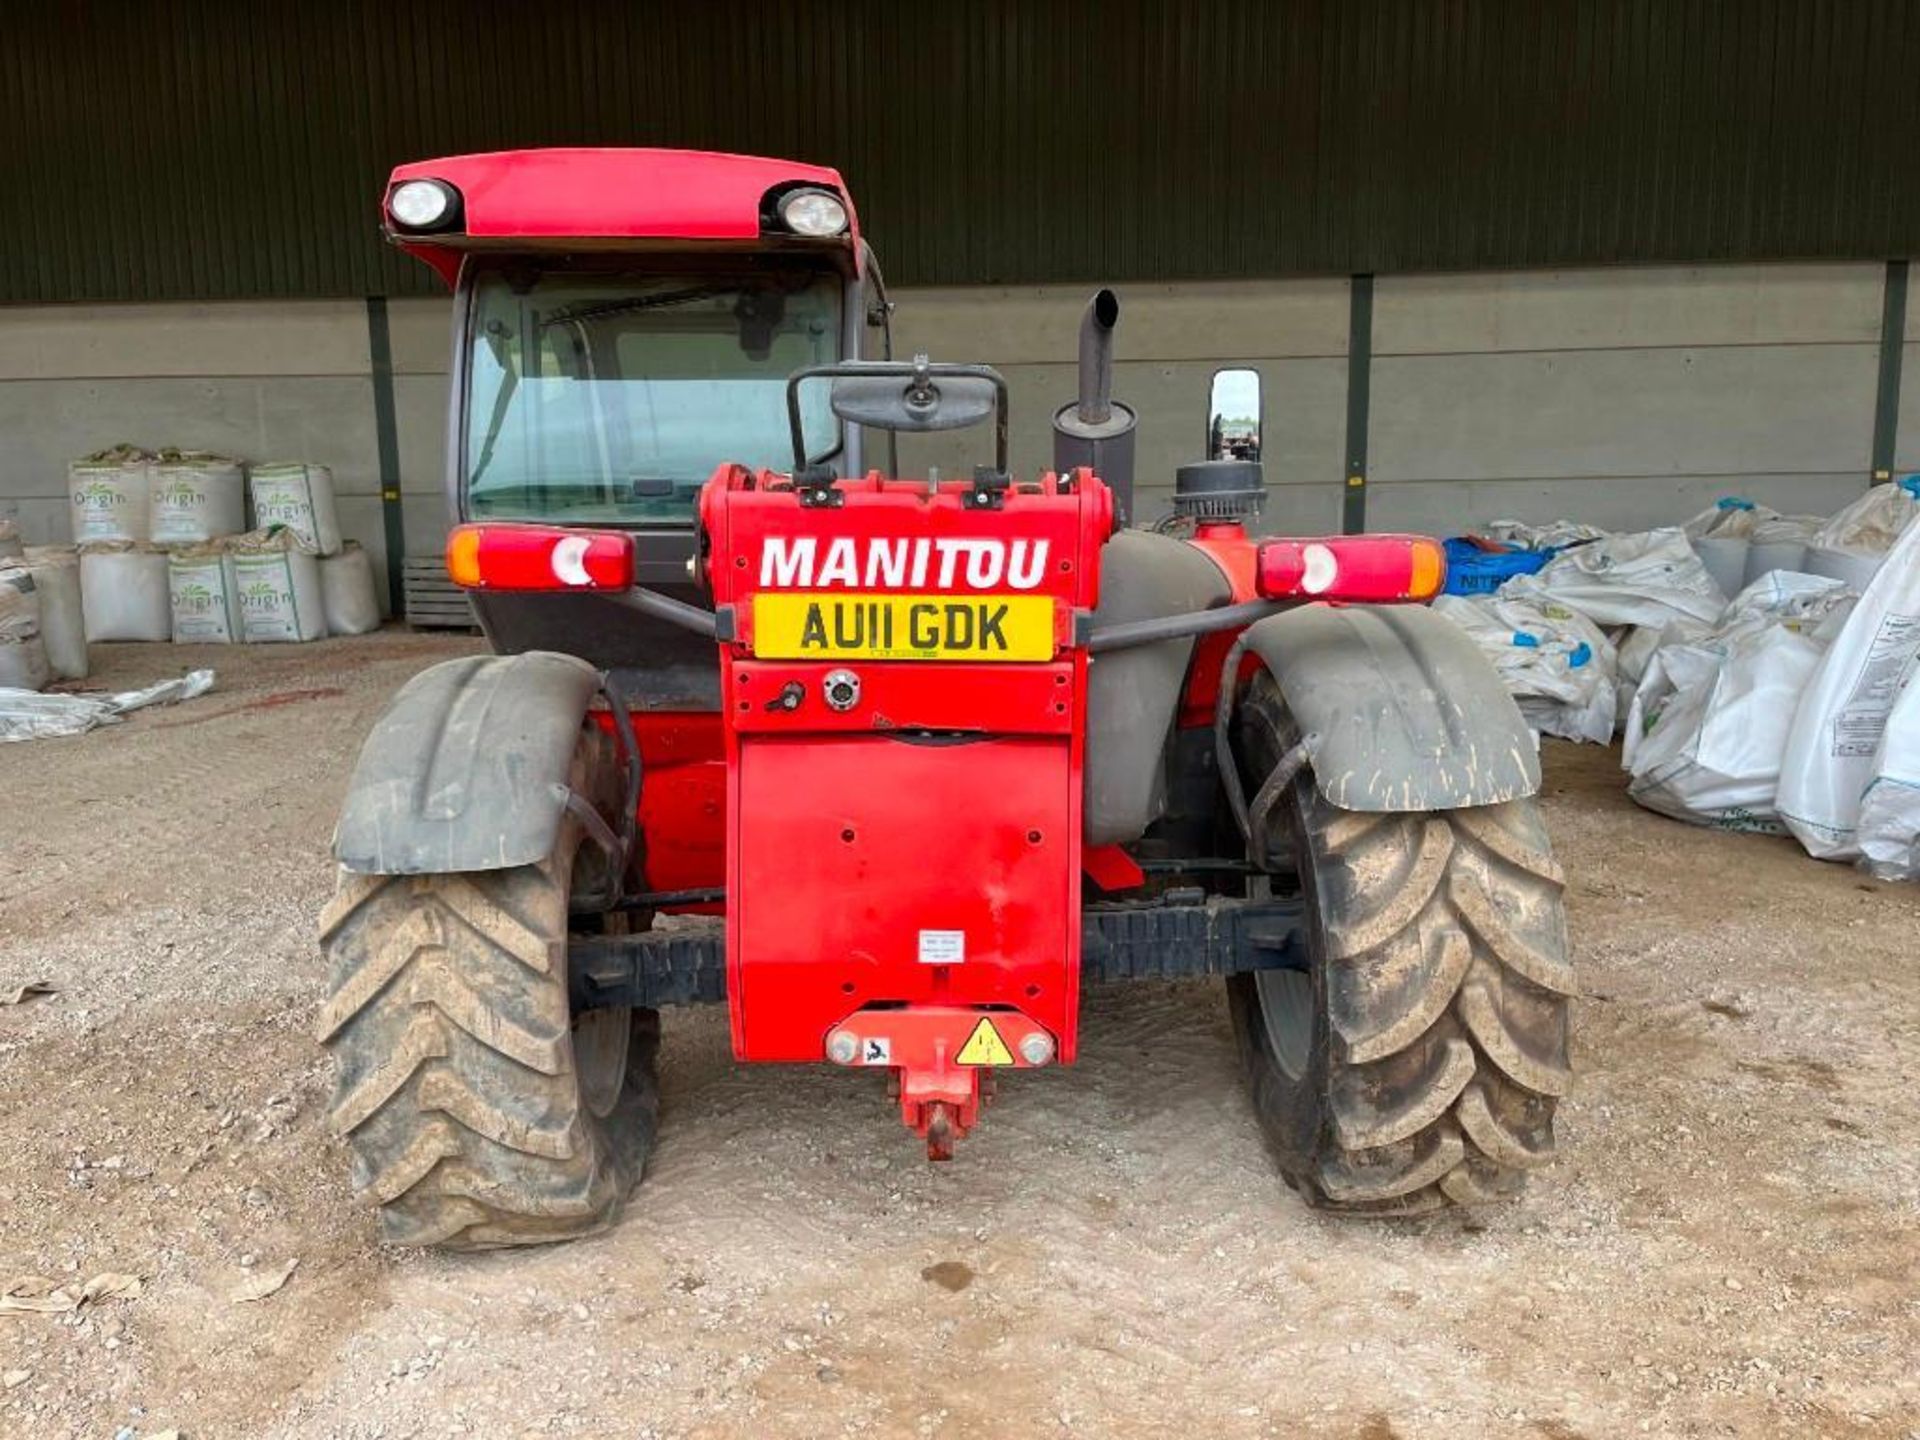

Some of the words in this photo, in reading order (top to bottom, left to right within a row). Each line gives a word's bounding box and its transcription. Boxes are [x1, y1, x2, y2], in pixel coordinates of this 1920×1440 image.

[75, 492, 126, 508] Origin
[155, 491, 205, 508] Origin
[256, 503, 310, 519] Origin
[758, 537, 1050, 589] MANITOU
[800, 602, 893, 649] AU11
[908, 603, 1009, 651] GDK
